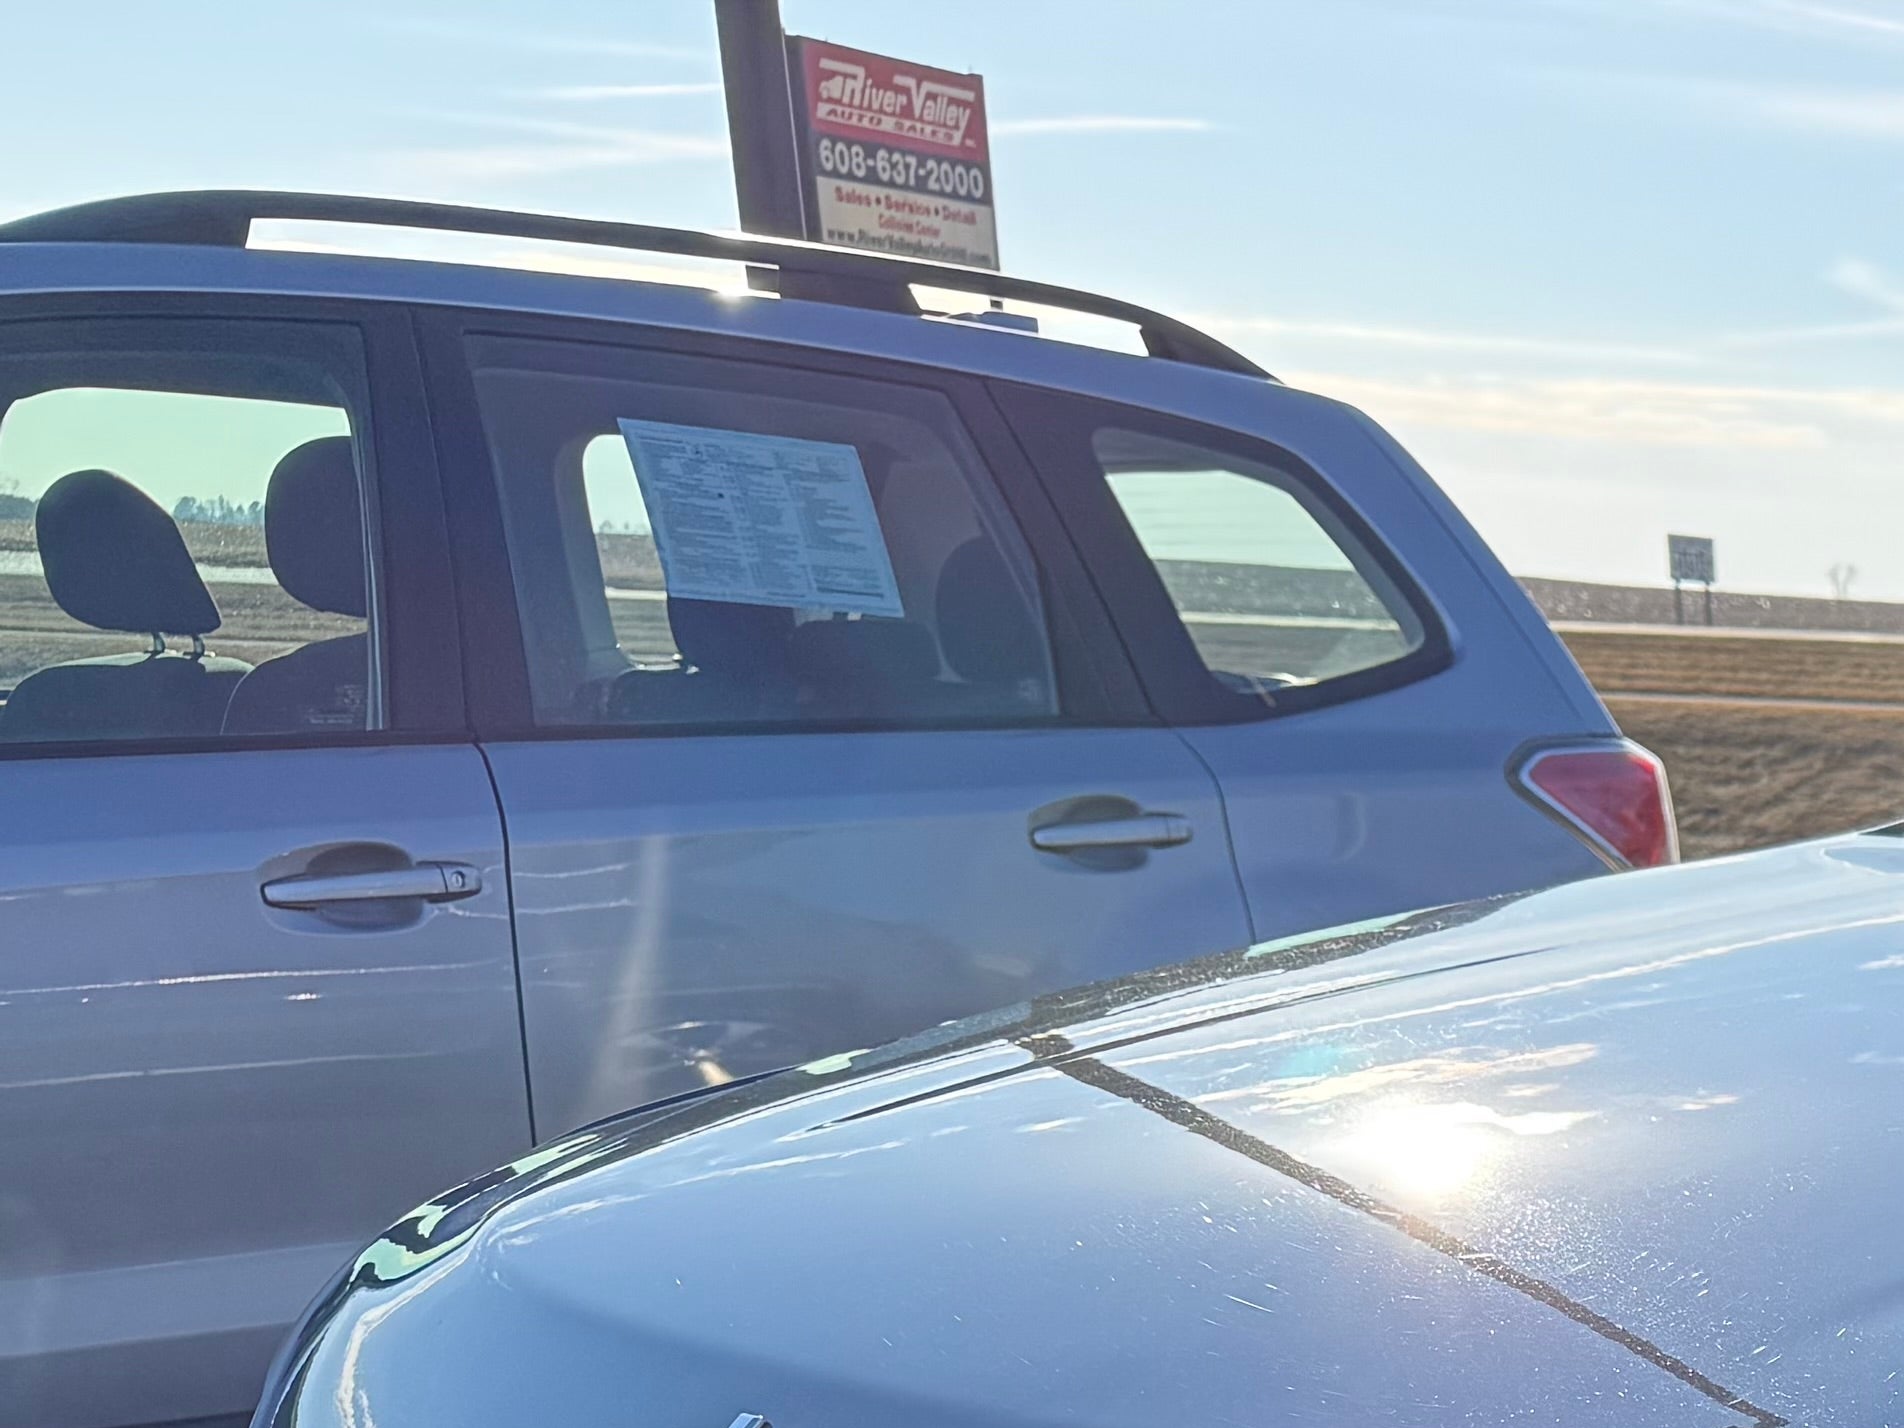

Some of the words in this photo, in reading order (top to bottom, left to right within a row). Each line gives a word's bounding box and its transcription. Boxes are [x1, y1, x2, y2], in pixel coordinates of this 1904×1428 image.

[818, 58, 908, 116] River
[893, 74, 976, 147] Valley
[825, 106, 883, 130] AUTO
[893, 119, 956, 144] SALES
[818, 137, 985, 199] 608-637-2000
[833, 185, 873, 208] Sales
